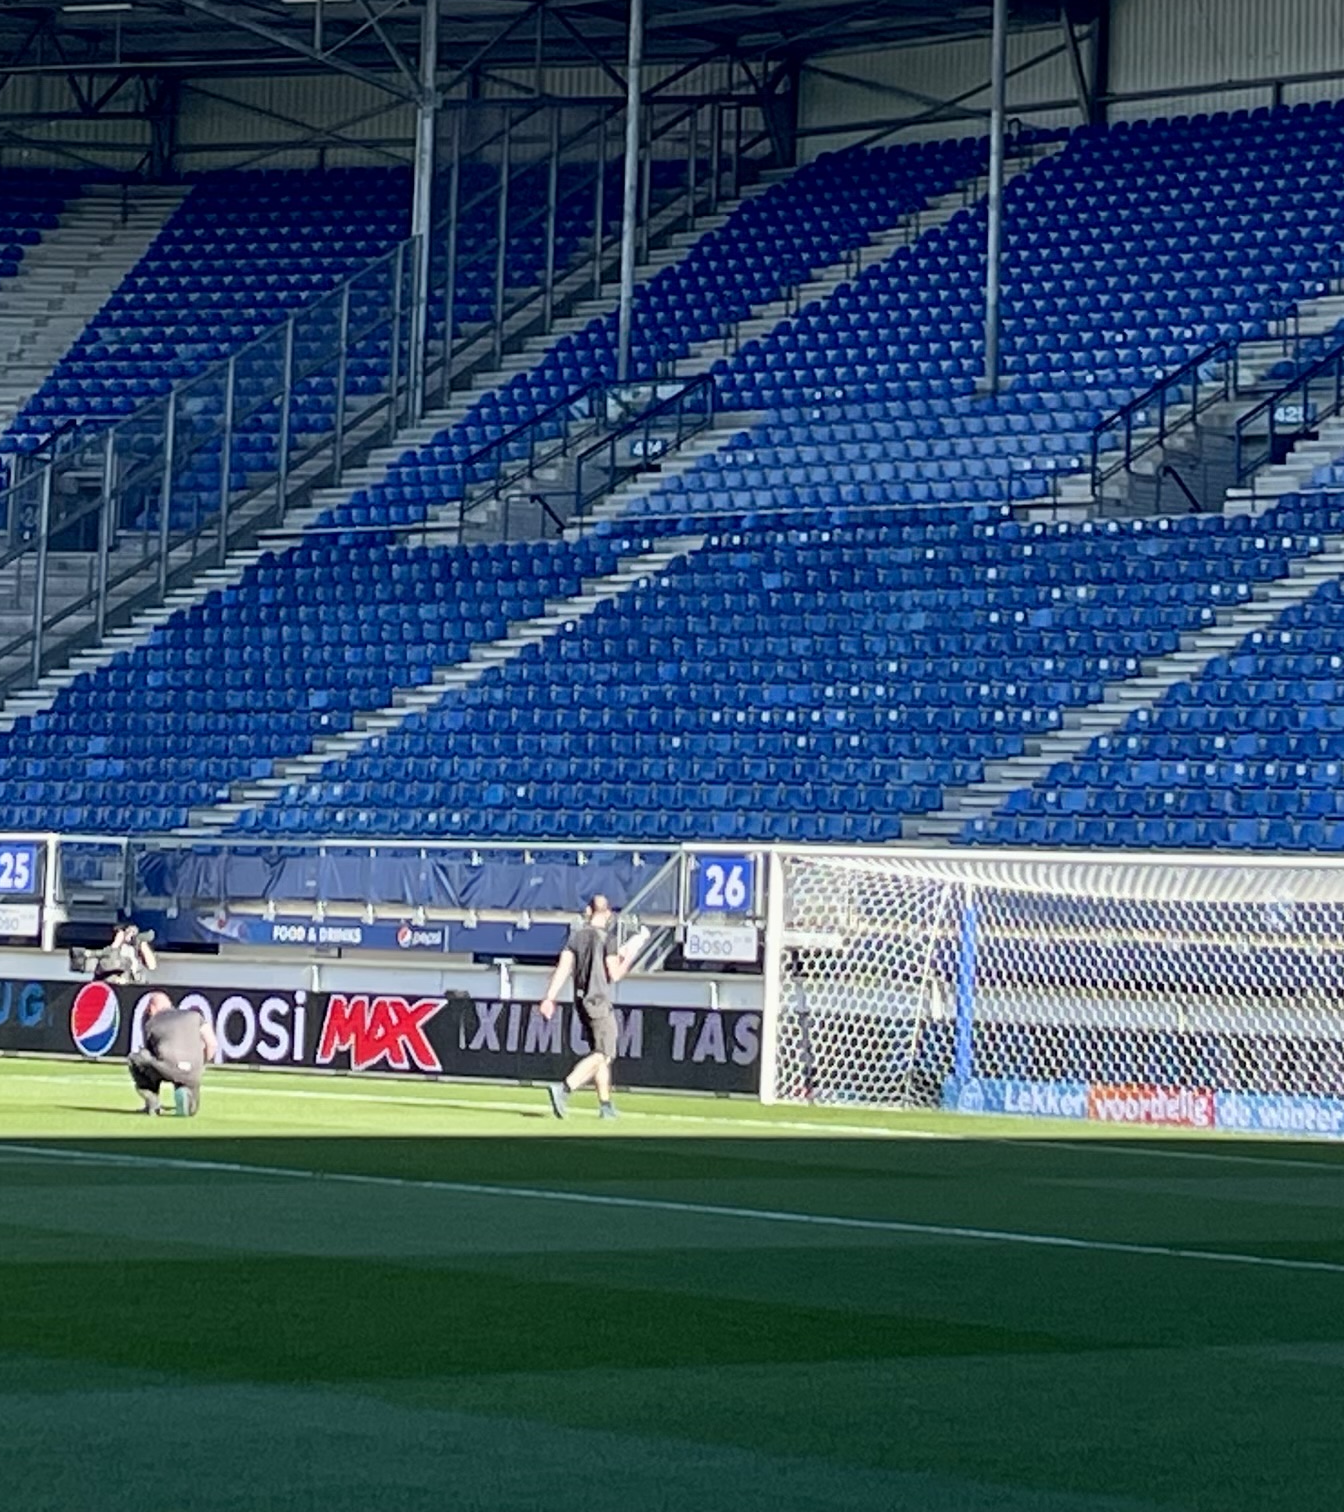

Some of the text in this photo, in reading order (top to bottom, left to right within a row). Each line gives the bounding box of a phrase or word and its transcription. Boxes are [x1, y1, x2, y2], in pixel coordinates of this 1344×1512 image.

[705, 864, 746, 907] 26
[272, 925, 305, 942] FOOD
[319, 926, 363, 944] DRINKS
[316, 993, 449, 1072] MAX
[459, 1002, 644, 1058] XIMUM
